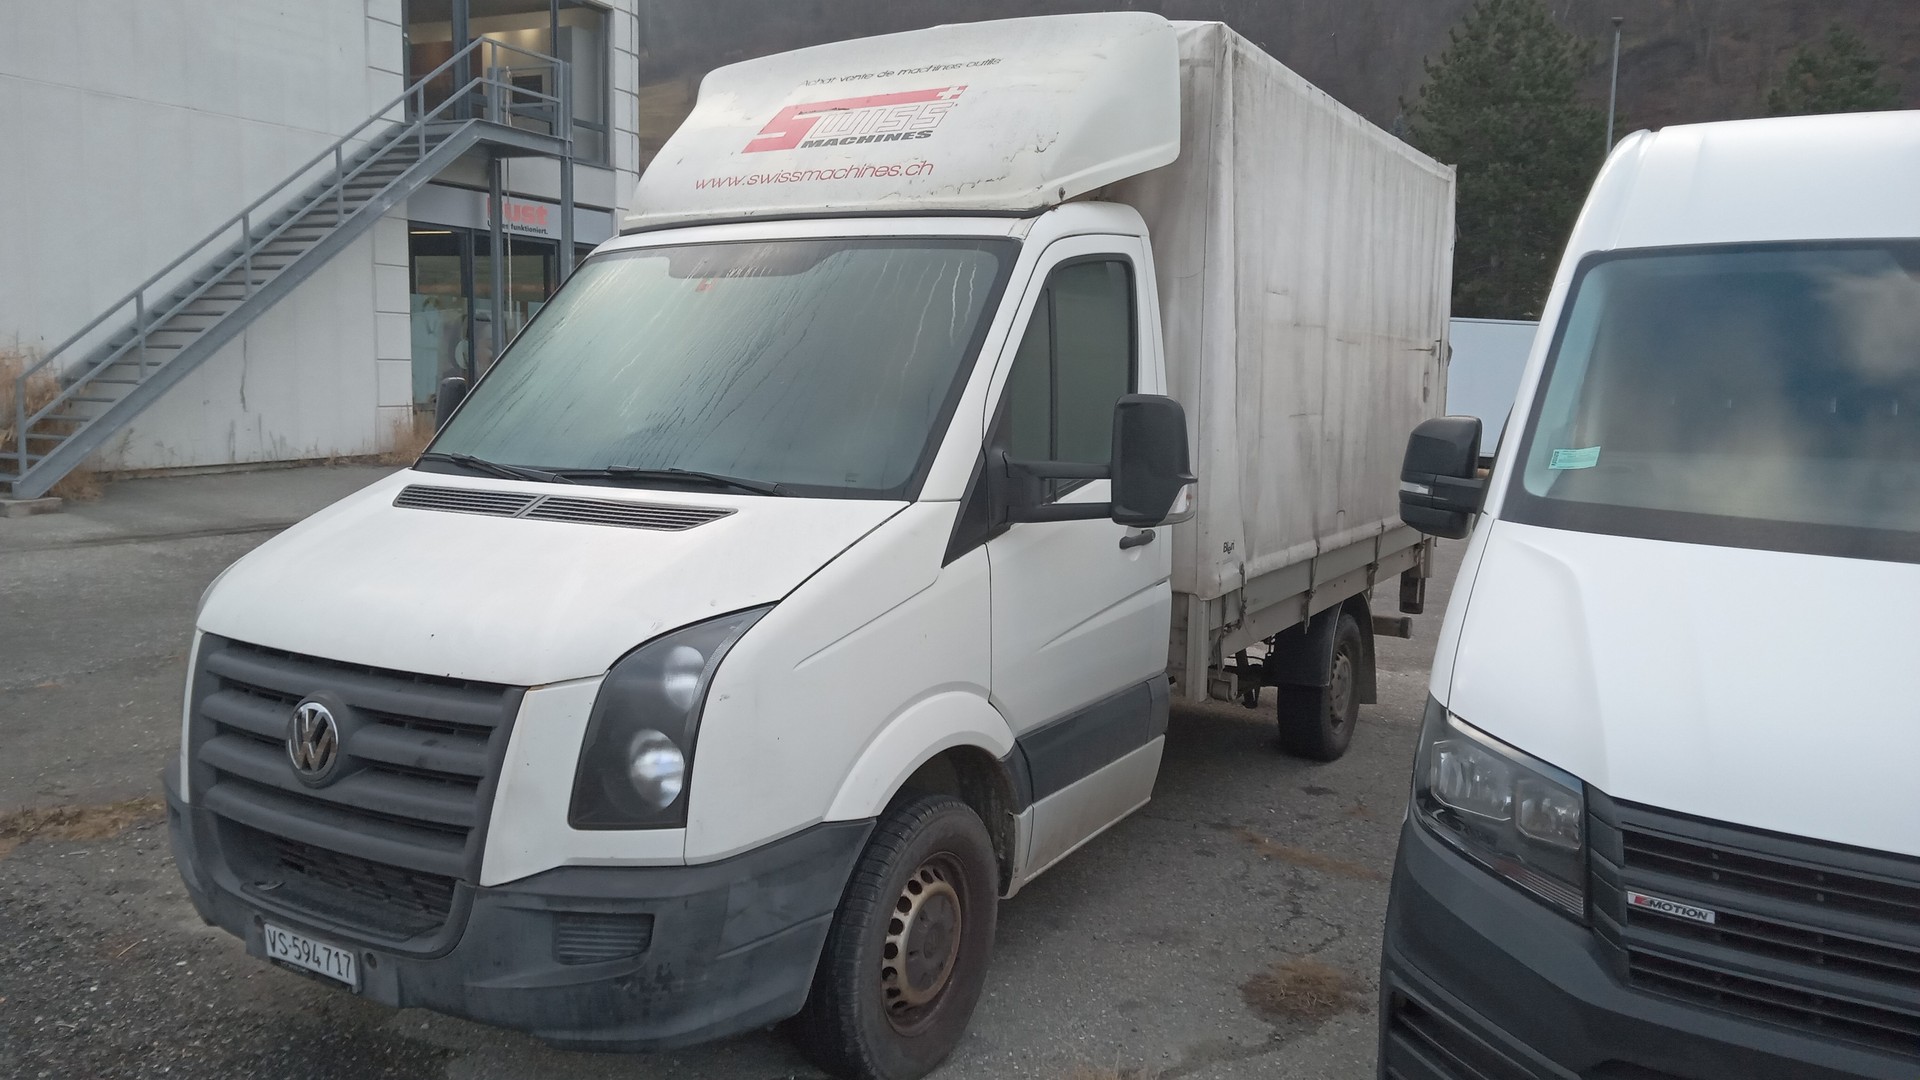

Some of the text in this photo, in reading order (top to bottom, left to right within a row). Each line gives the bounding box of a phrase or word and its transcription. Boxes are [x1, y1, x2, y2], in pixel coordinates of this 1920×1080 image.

[840, 73, 874, 82] vente
[876, 70, 895, 78] de
[897, 64, 963, 76] machines
[966, 58, 1004, 68] outils
[800, 130, 933, 149] MACHINES
[695, 160, 934, 190] www.swissmachines.ch
[487, 196, 549, 226] ust
